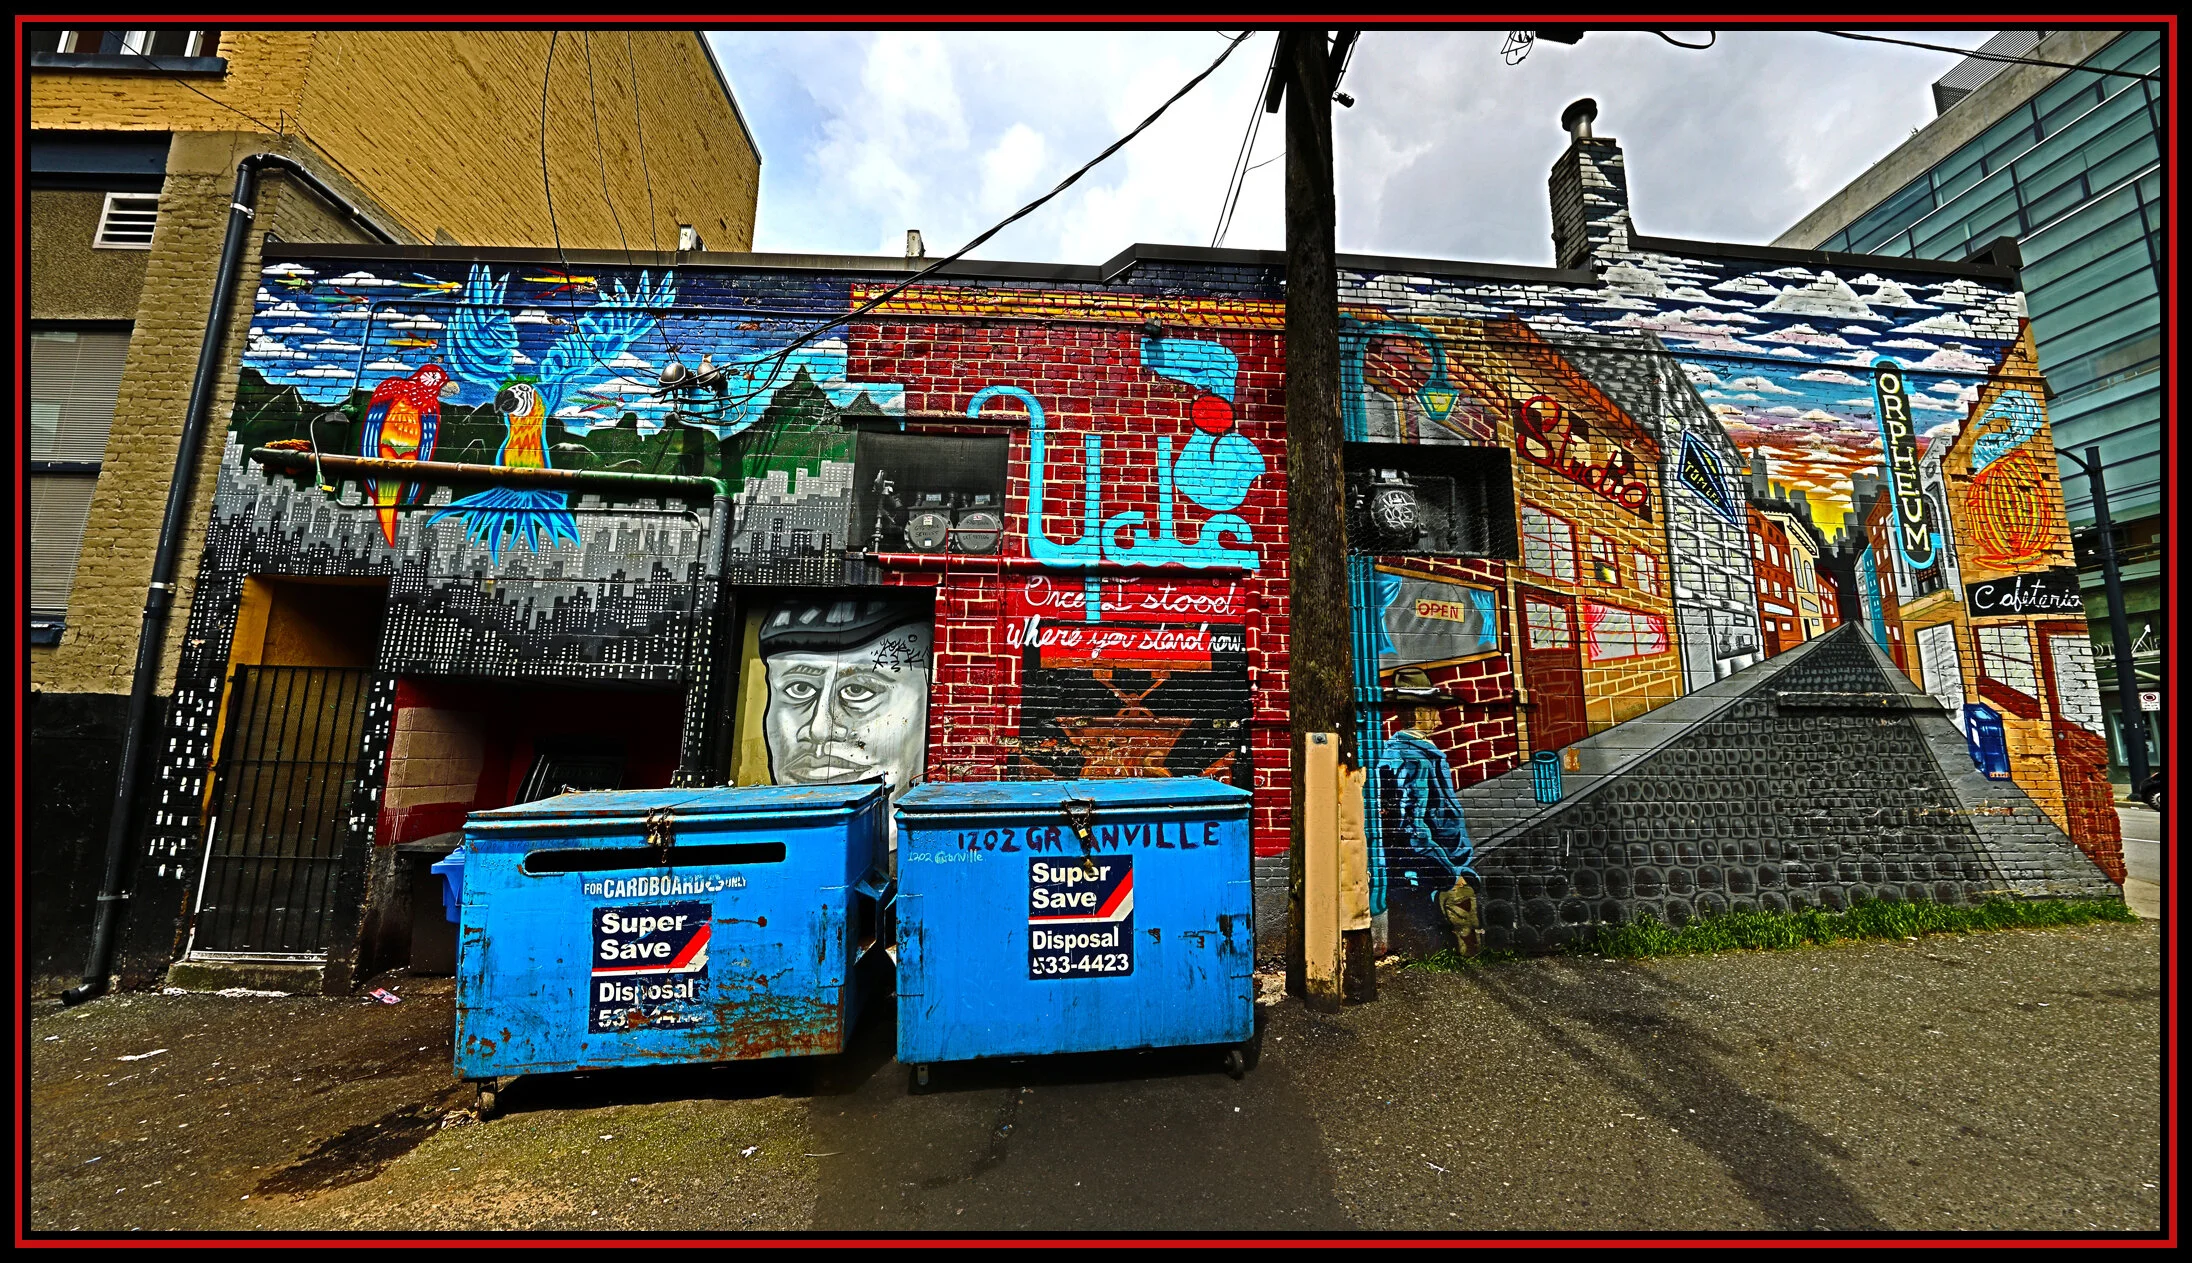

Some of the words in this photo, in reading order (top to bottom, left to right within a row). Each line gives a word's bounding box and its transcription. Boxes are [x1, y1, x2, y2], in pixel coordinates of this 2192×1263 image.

[1518, 395, 1648, 508] Studio
[1879, 373, 1930, 551] ORPHEUM
[1025, 575, 1086, 607] Once
[1140, 582, 1237, 615] stood
[1975, 576, 2083, 612] Cafeteria
[1418, 602, 1459, 620] OPEN
[1006, 613, 1083, 650] Where
[1086, 629, 1139, 659] you
[1138, 622, 1209, 651] stand
[958, 828, 1020, 853] 1202
[584, 883, 603, 895] FOR
[603, 875, 705, 899] CARDBOARD
[725, 876, 747, 888] ONLY
[1032, 863, 1111, 888] Super
[1032, 888, 1097, 909] Save
[601, 913, 688, 937] Super
[600, 938, 671, 961] Save
[1032, 926, 1119, 953] Disposal
[1032, 954, 1130, 975] 533-4423
